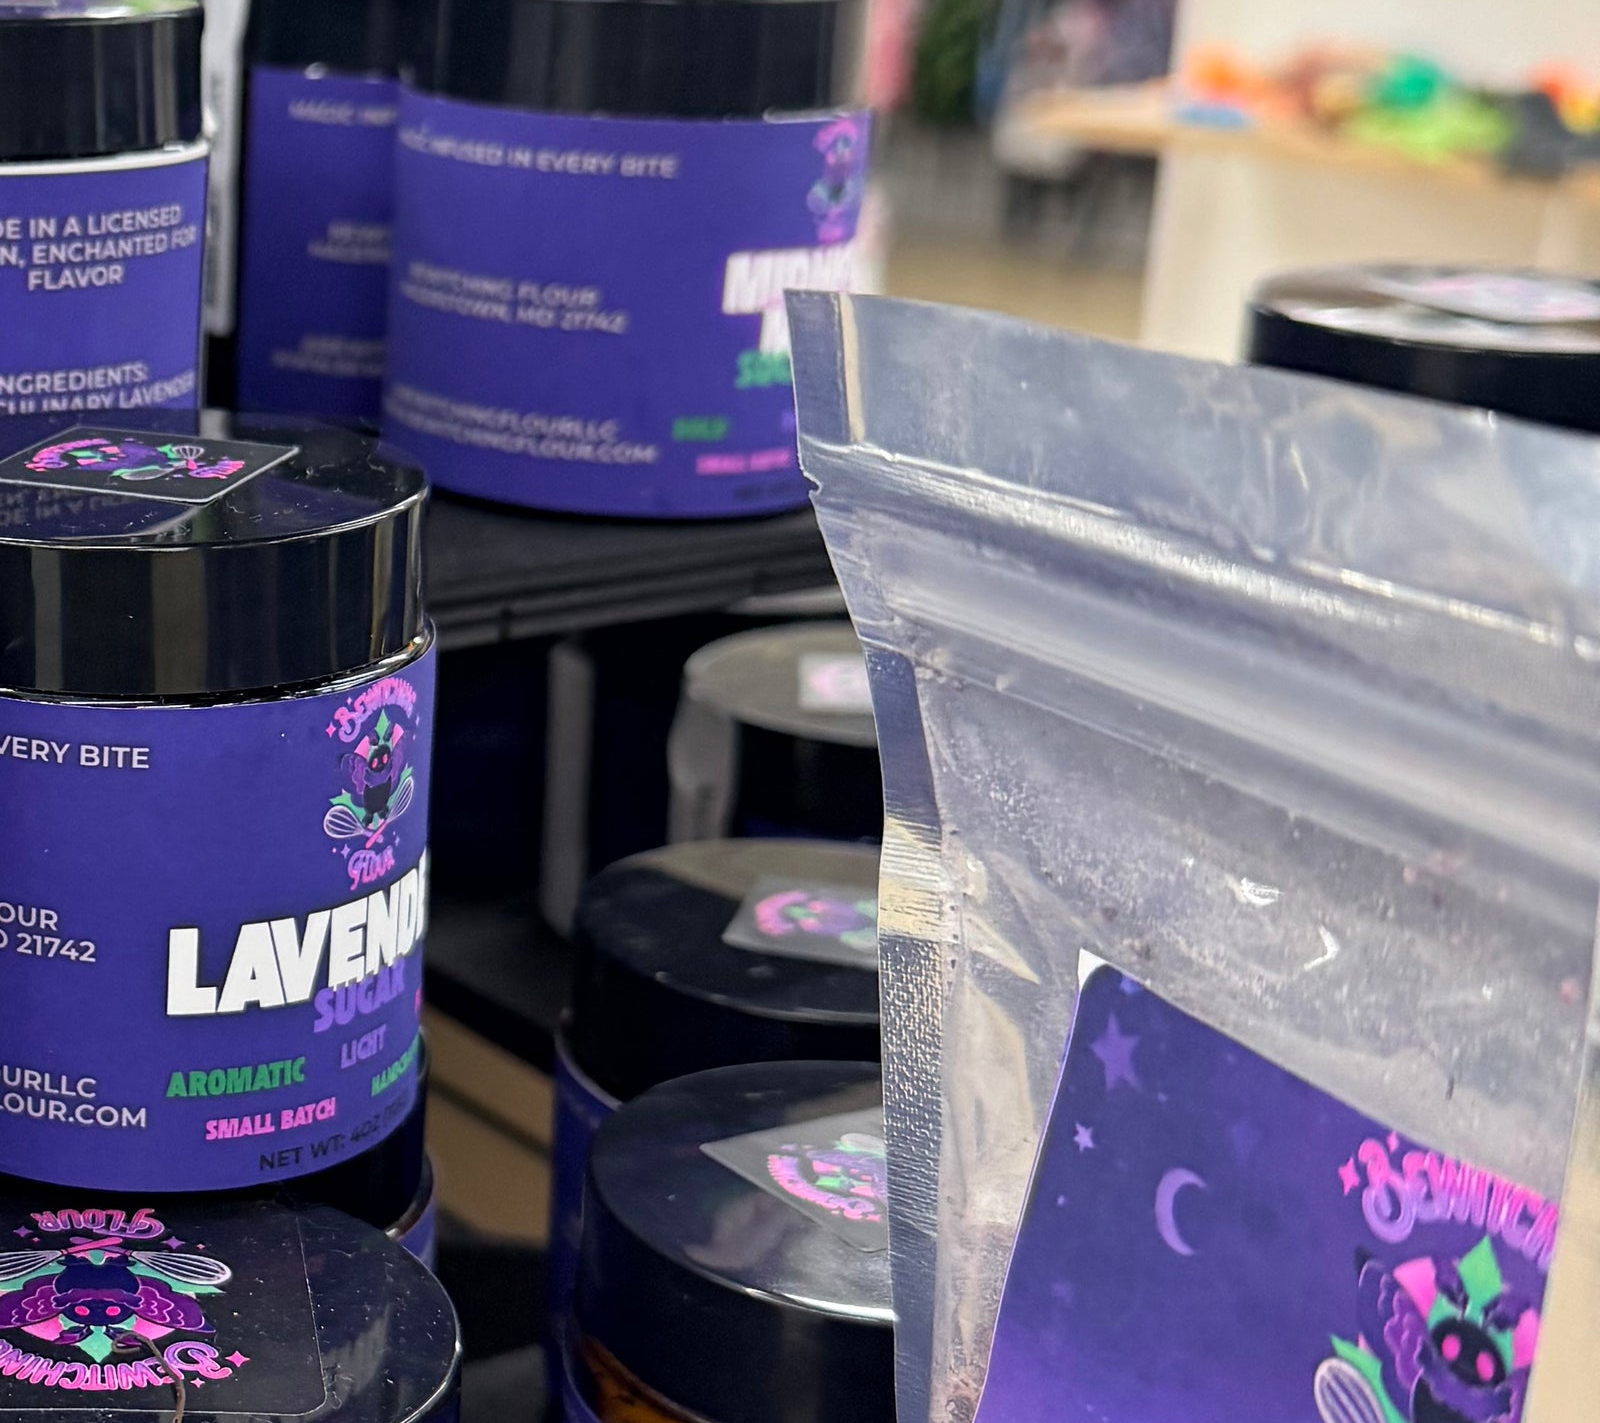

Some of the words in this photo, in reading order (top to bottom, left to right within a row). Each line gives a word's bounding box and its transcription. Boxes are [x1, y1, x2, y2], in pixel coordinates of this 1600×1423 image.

[29, 216, 57, 240] IN
[63, 216, 81, 237] A
[87, 205, 183, 236] LICENSED
[32, 232, 169, 266] ENCHANTED
[28, 265, 125, 292] FLAVOR
[79, 745, 151, 770] BITE
[16, 932, 97, 963] 21742
[165, 1056, 307, 1098] AROMATIC
[205, 1114, 276, 1142] SMALL
[280, 1096, 337, 1131] BATCH
[259, 1146, 304, 1171] NET
